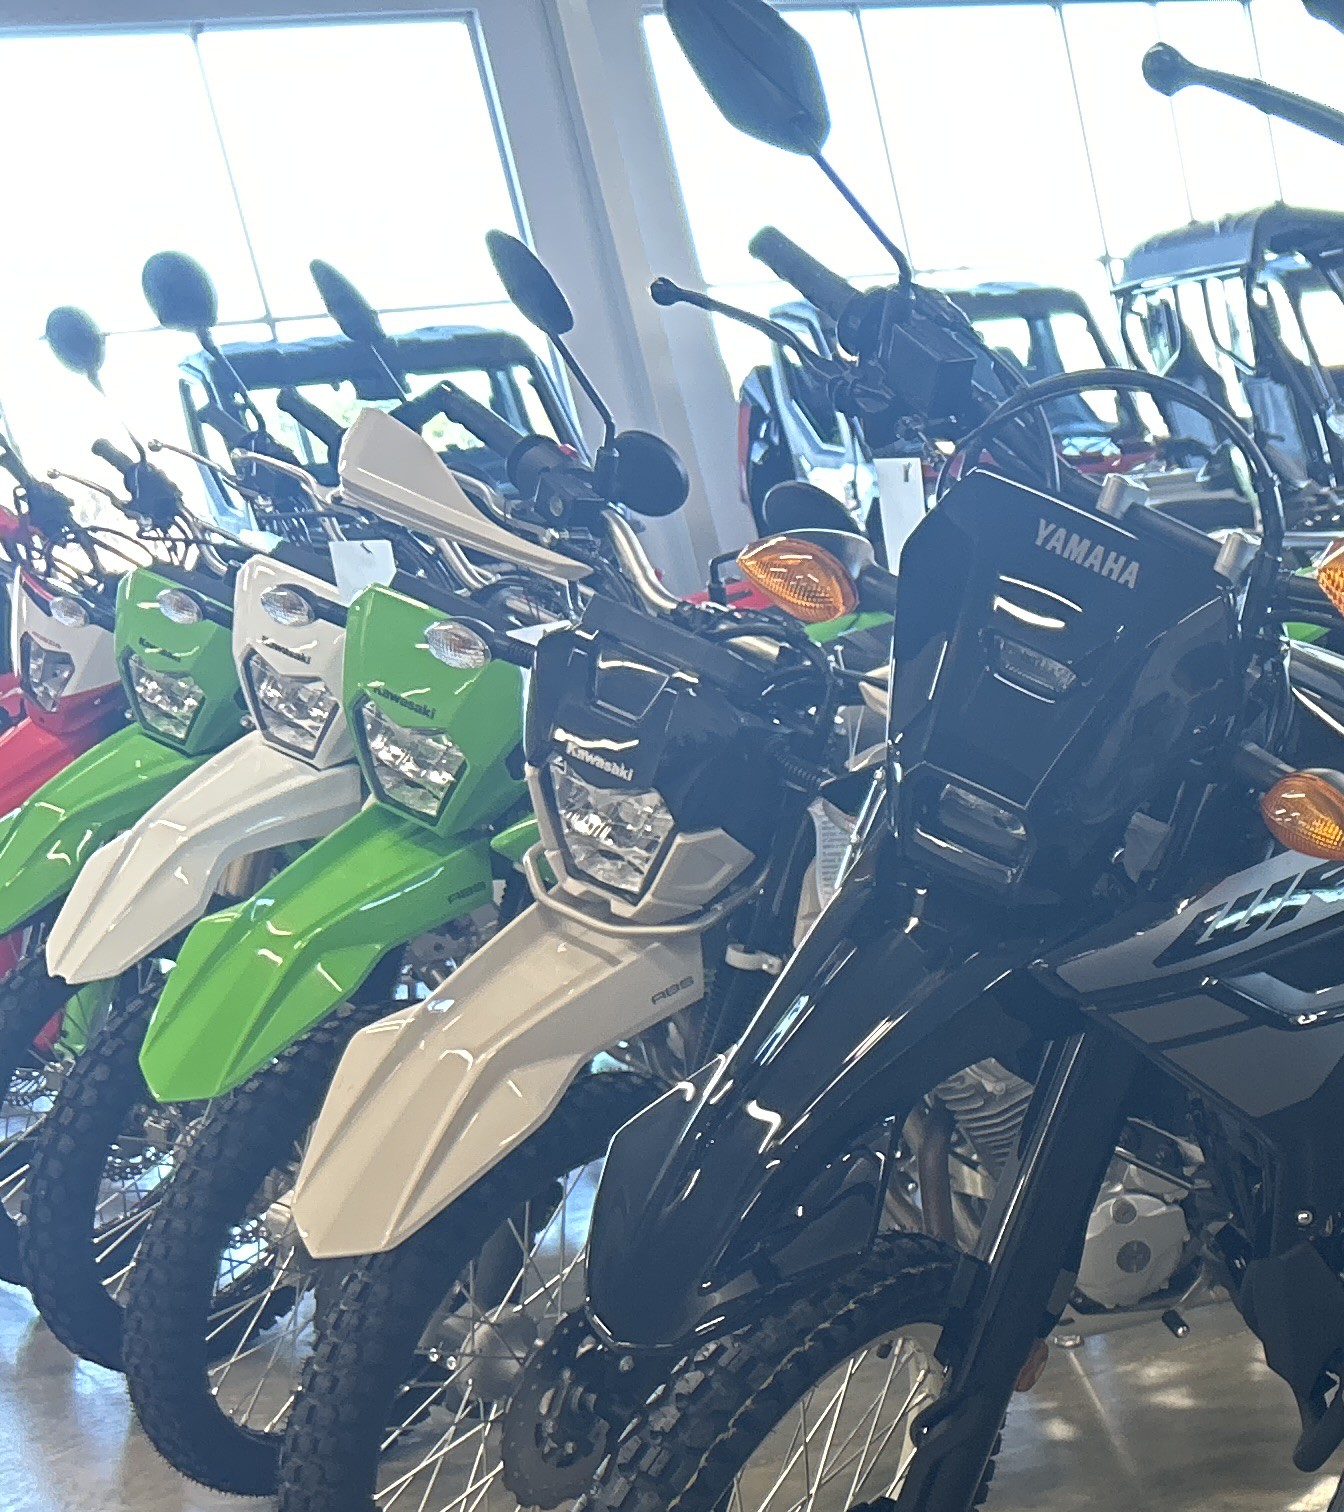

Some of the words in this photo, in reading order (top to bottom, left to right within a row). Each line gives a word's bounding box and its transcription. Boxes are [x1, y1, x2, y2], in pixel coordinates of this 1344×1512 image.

[1035, 518, 1140, 590] YAMAHA
[566, 741, 634, 782] Kawasaki
[652, 975, 694, 1004] ABS
